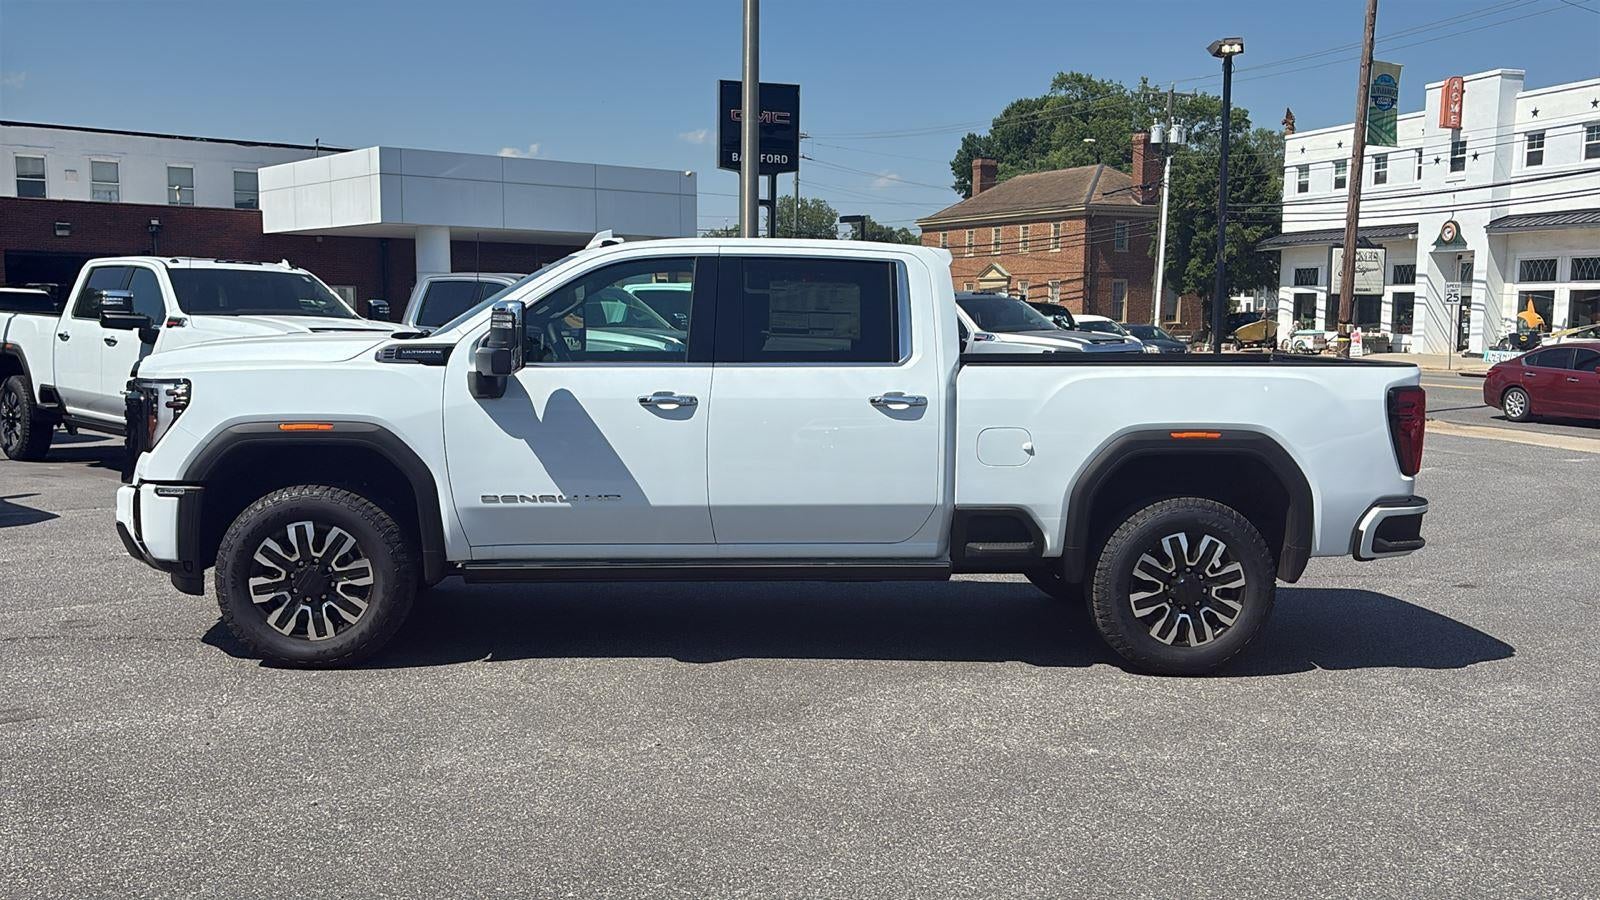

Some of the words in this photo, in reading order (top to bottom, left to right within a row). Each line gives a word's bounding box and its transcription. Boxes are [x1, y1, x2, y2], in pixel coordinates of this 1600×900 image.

[1449, 81, 1460, 125] ACME
[731, 109, 790, 124] GMC
[1446, 293, 1459, 302] 25
[481, 495, 578, 503] DENALI
[584, 495, 621, 503] HD
